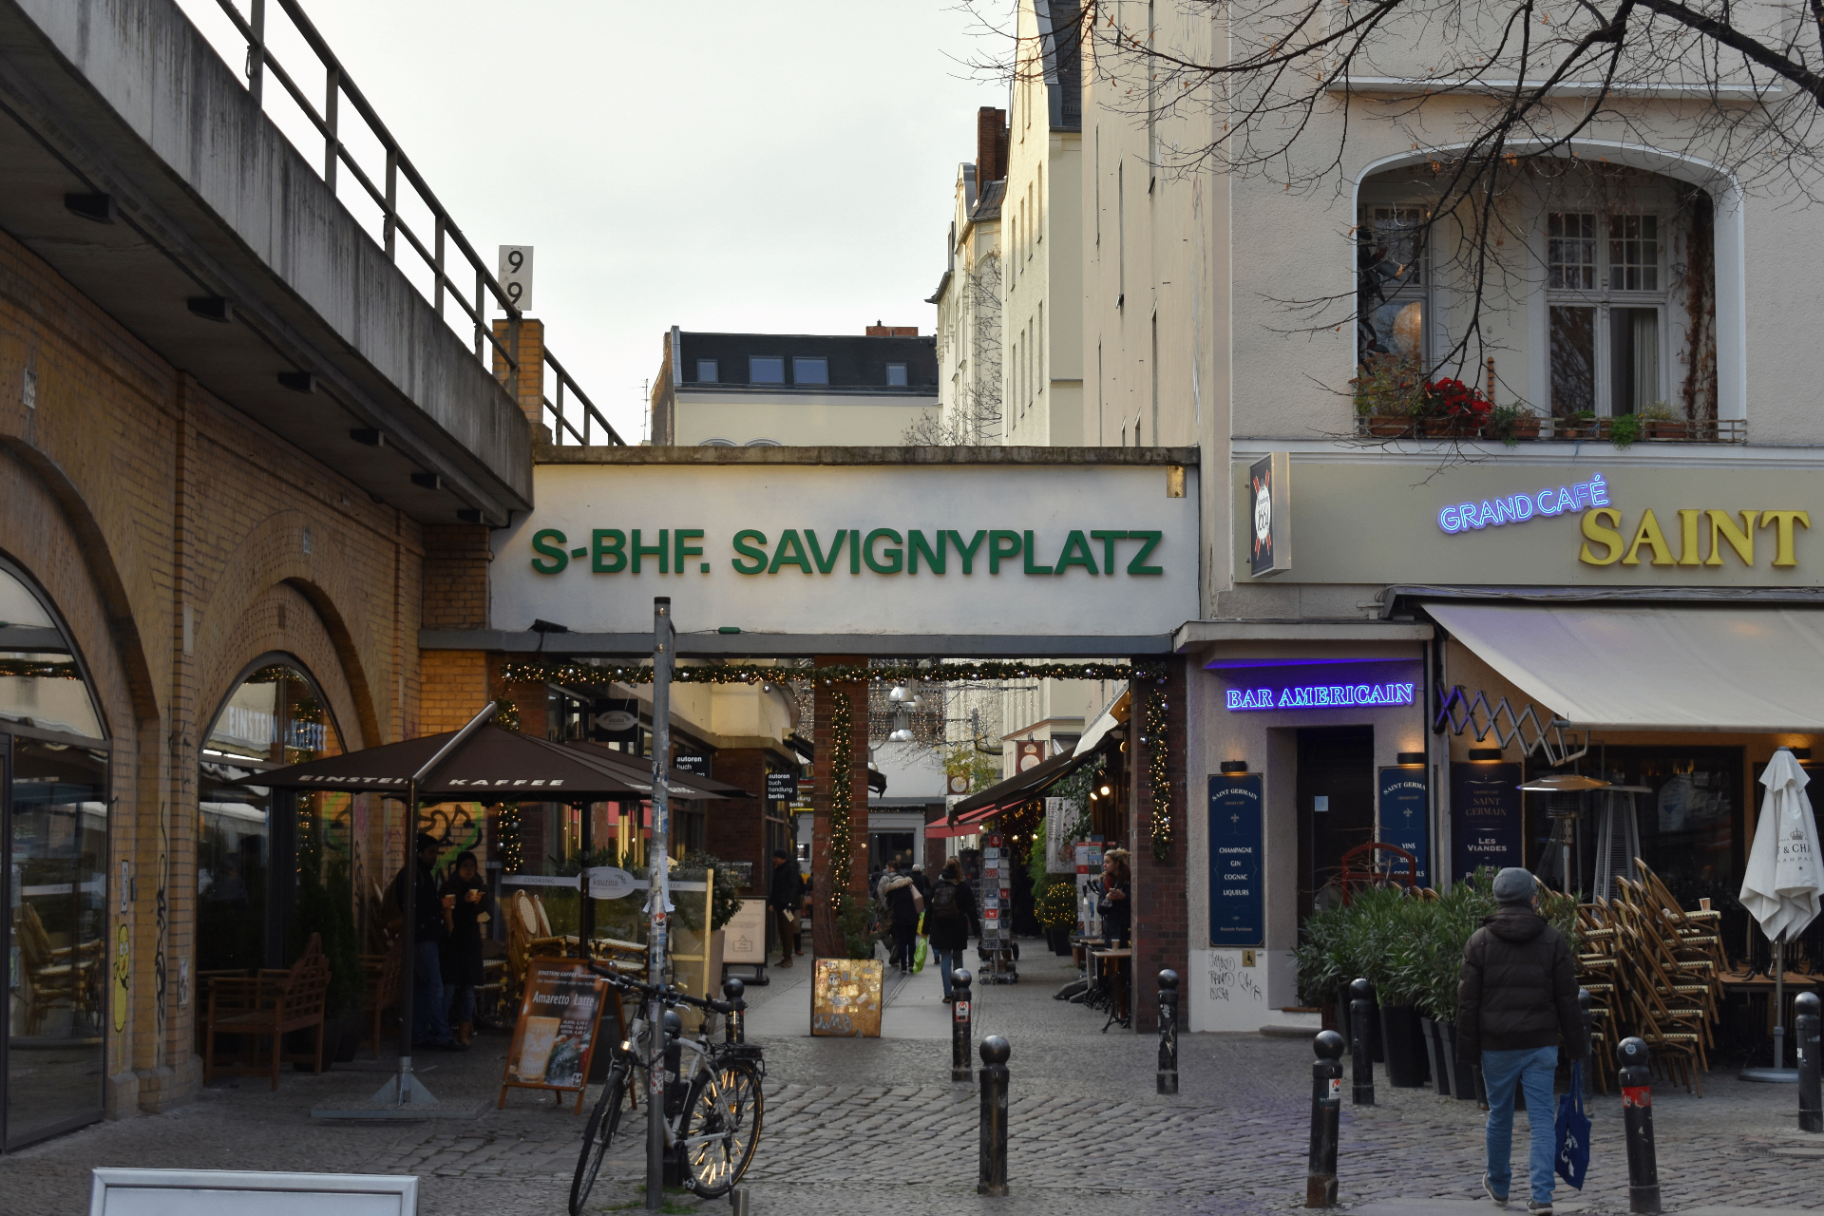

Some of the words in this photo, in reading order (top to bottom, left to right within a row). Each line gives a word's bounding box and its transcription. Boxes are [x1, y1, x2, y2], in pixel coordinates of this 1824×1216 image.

[508, 250, 524, 274] 9
[507, 282, 523, 305] 9
[1439, 495, 1534, 533] GRAND
[1537, 473, 1610, 514] CAFÉ
[1579, 507, 1811, 567] SAINT
[531, 528, 710, 574] S-BHF.
[731, 528, 1163, 574] SAVIGNYPLATZ
[1226, 689, 1274, 709] BAR
[1278, 684, 1414, 708] AMERICAIN
[228, 706, 278, 744] EINSTEIN
[298, 775, 409, 785] EINSTEI
[448, 778, 566, 787] KAFFEE
[1383, 782, 1402, 795] SAINT
[1211, 789, 1230, 802] SAINT
[1230, 788, 1258, 800] GERMAIN
[1473, 797, 1501, 805] SAINT
[1466, 807, 1507, 816] GERMAIN
[532, 991, 570, 1005] Amaretto
[574, 993, 595, 1006] Latte
